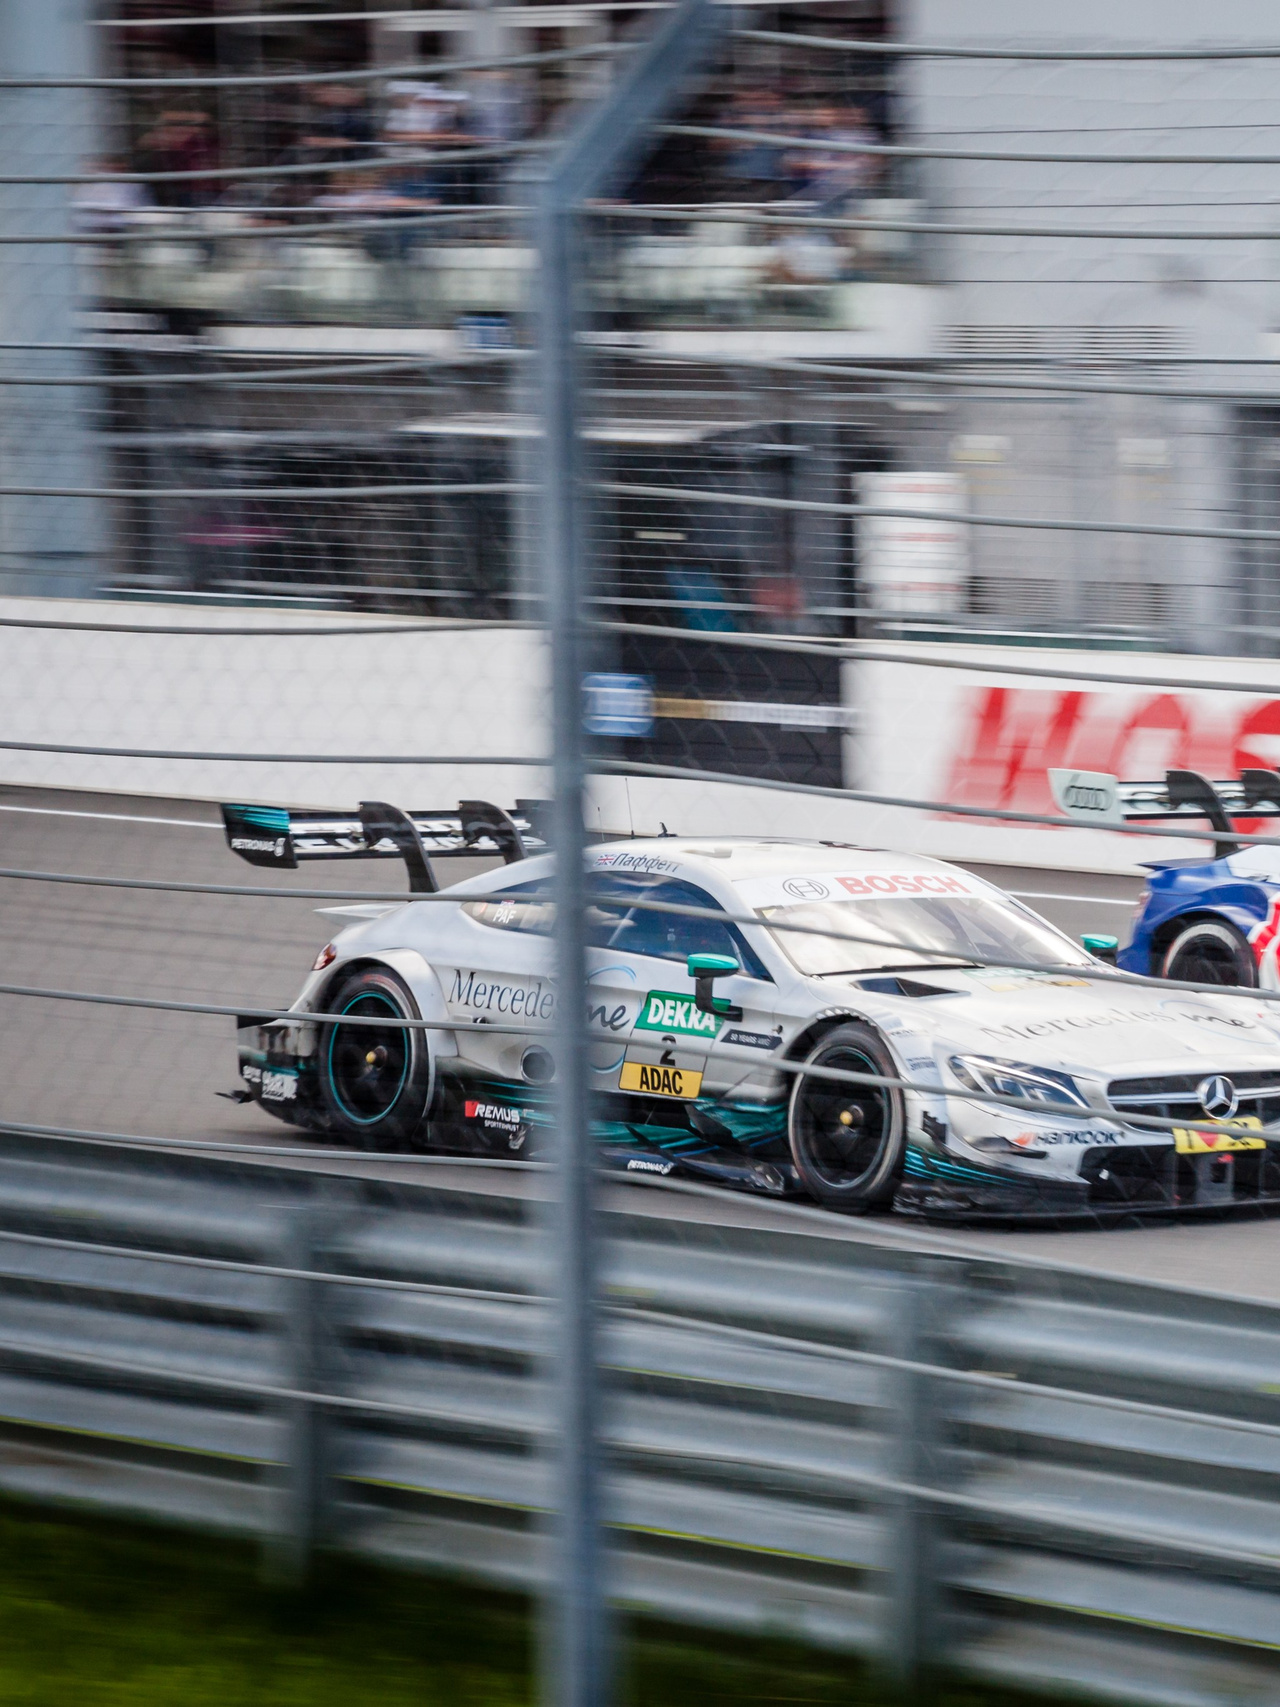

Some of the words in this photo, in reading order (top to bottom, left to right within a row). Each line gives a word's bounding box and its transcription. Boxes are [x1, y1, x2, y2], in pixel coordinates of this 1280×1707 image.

[834, 875, 972, 895] BOSCH
[492, 908, 516, 924] PAF
[448, 968, 560, 1022] Mercede
[646, 997, 716, 1032] DEKRA
[659, 1035, 677, 1066] 2
[639, 1066, 683, 1095] ADAC
[475, 1104, 520, 1123] REMUS
